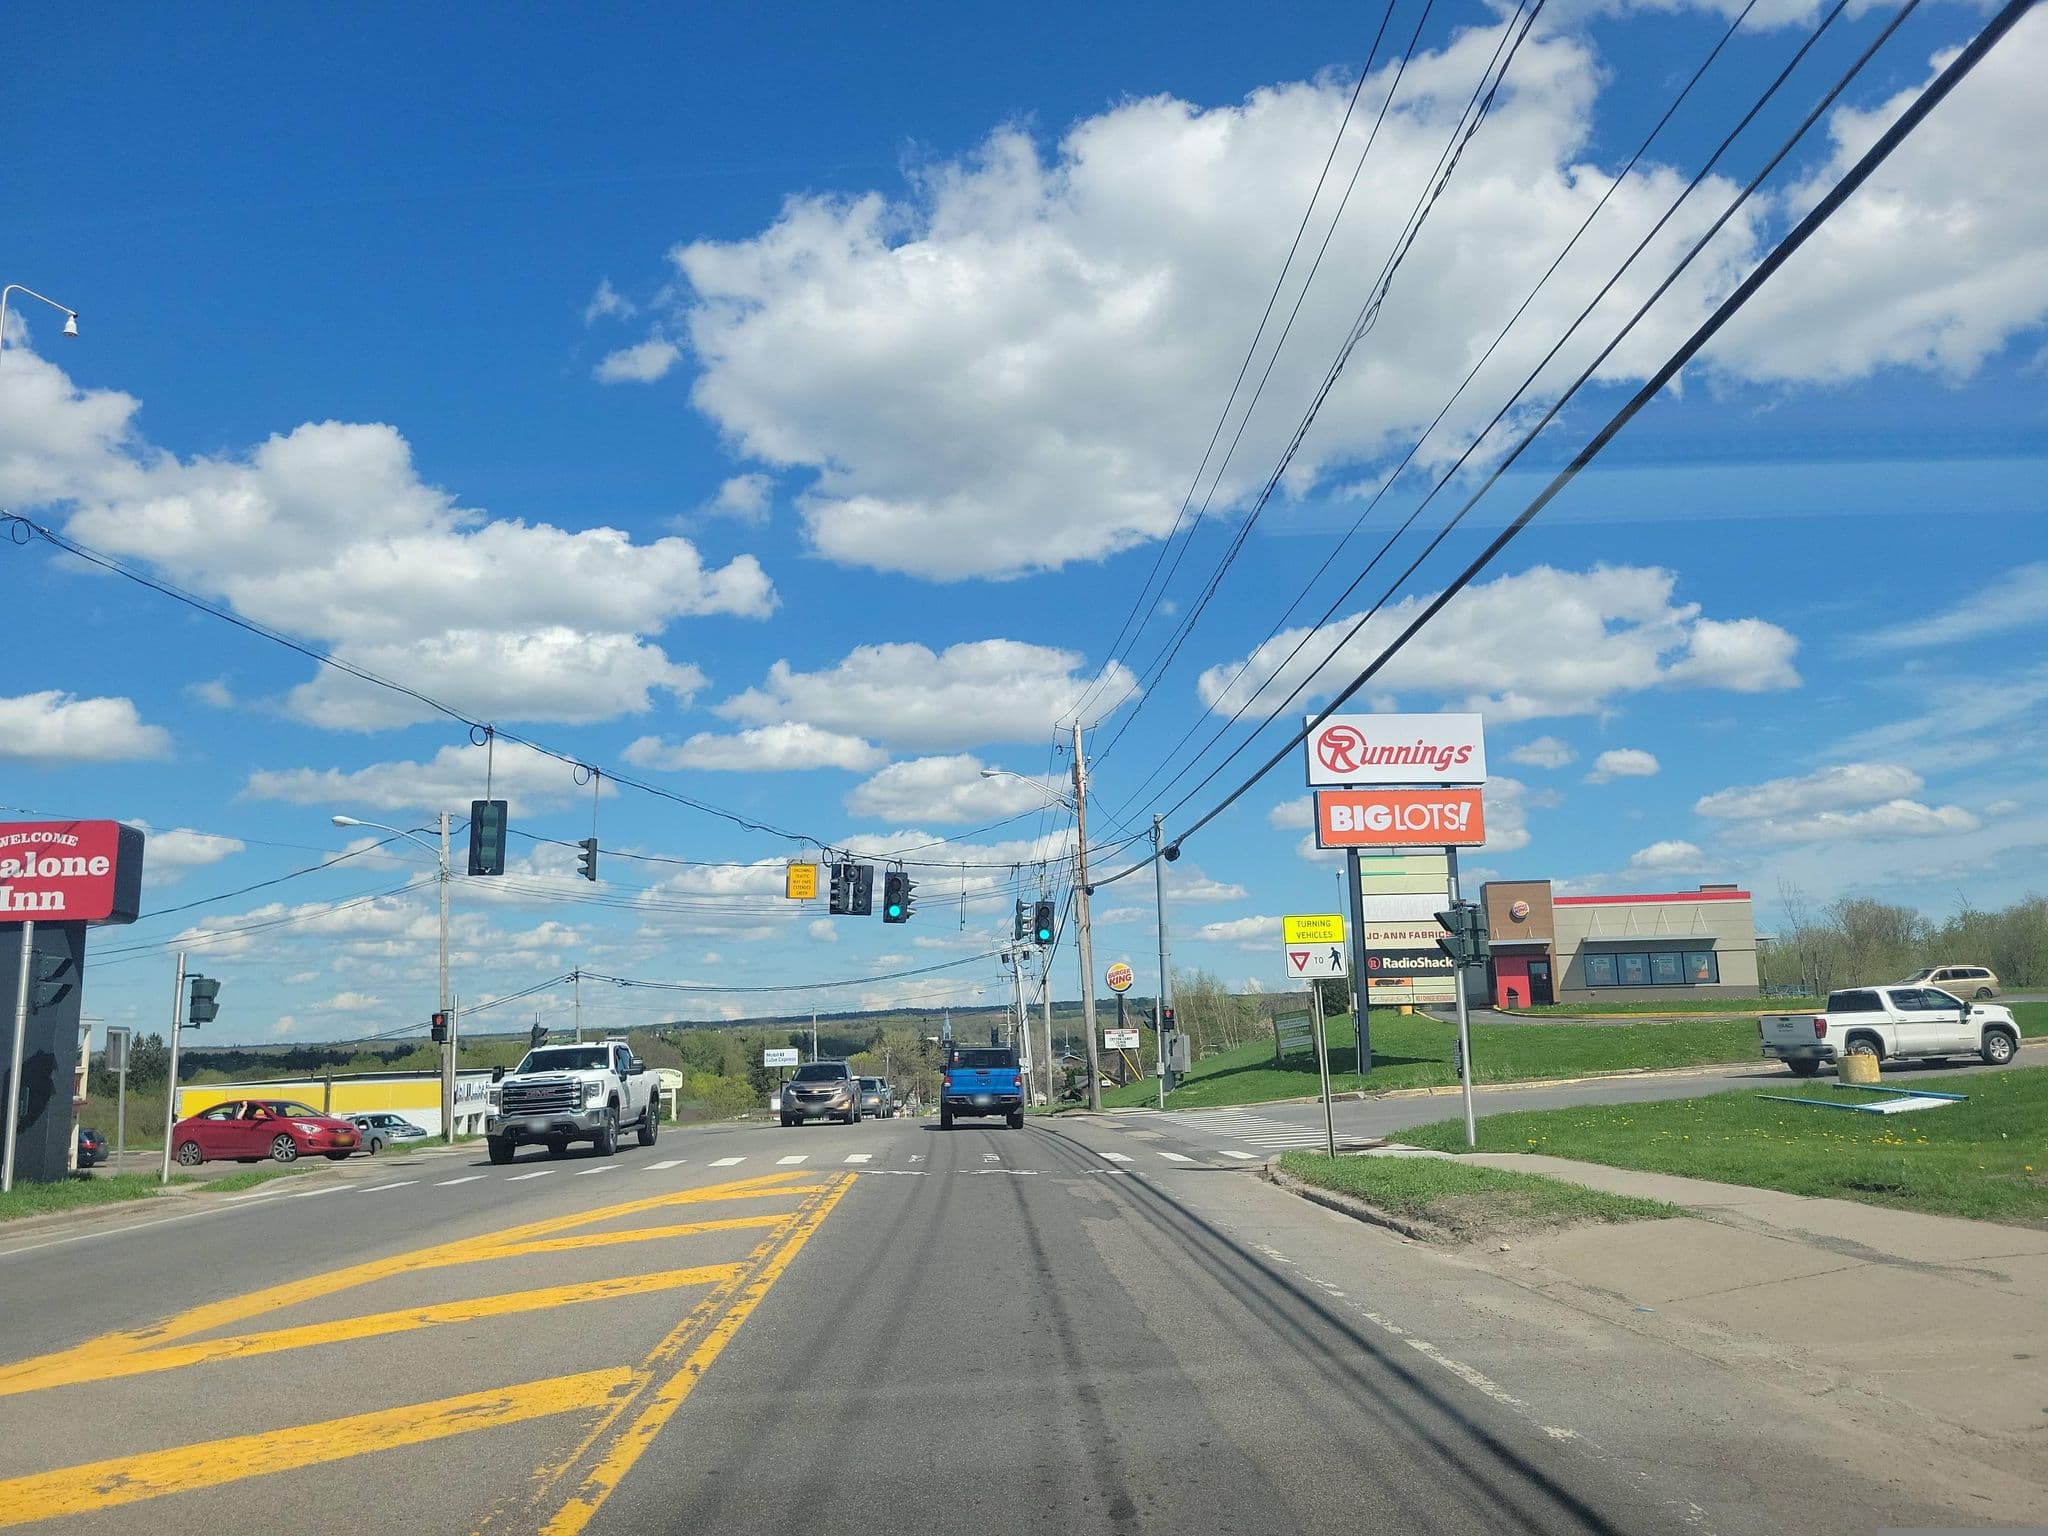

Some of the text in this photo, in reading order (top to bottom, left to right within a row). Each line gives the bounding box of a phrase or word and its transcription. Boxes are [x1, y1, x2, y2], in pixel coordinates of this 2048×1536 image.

[1317, 725, 1473, 774] Runnings
[0, 851, 110, 878] alone
[0, 885, 65, 912] Inn
[1296, 920, 1332, 928] TURNING
[1296, 931, 1333, 939] VEHICLES
[1314, 956, 1324, 964] TO
[1382, 956, 1454, 969] RadioShack
[1108, 968, 1132, 979] BURGER
[1109, 974, 1132, 986] KING
